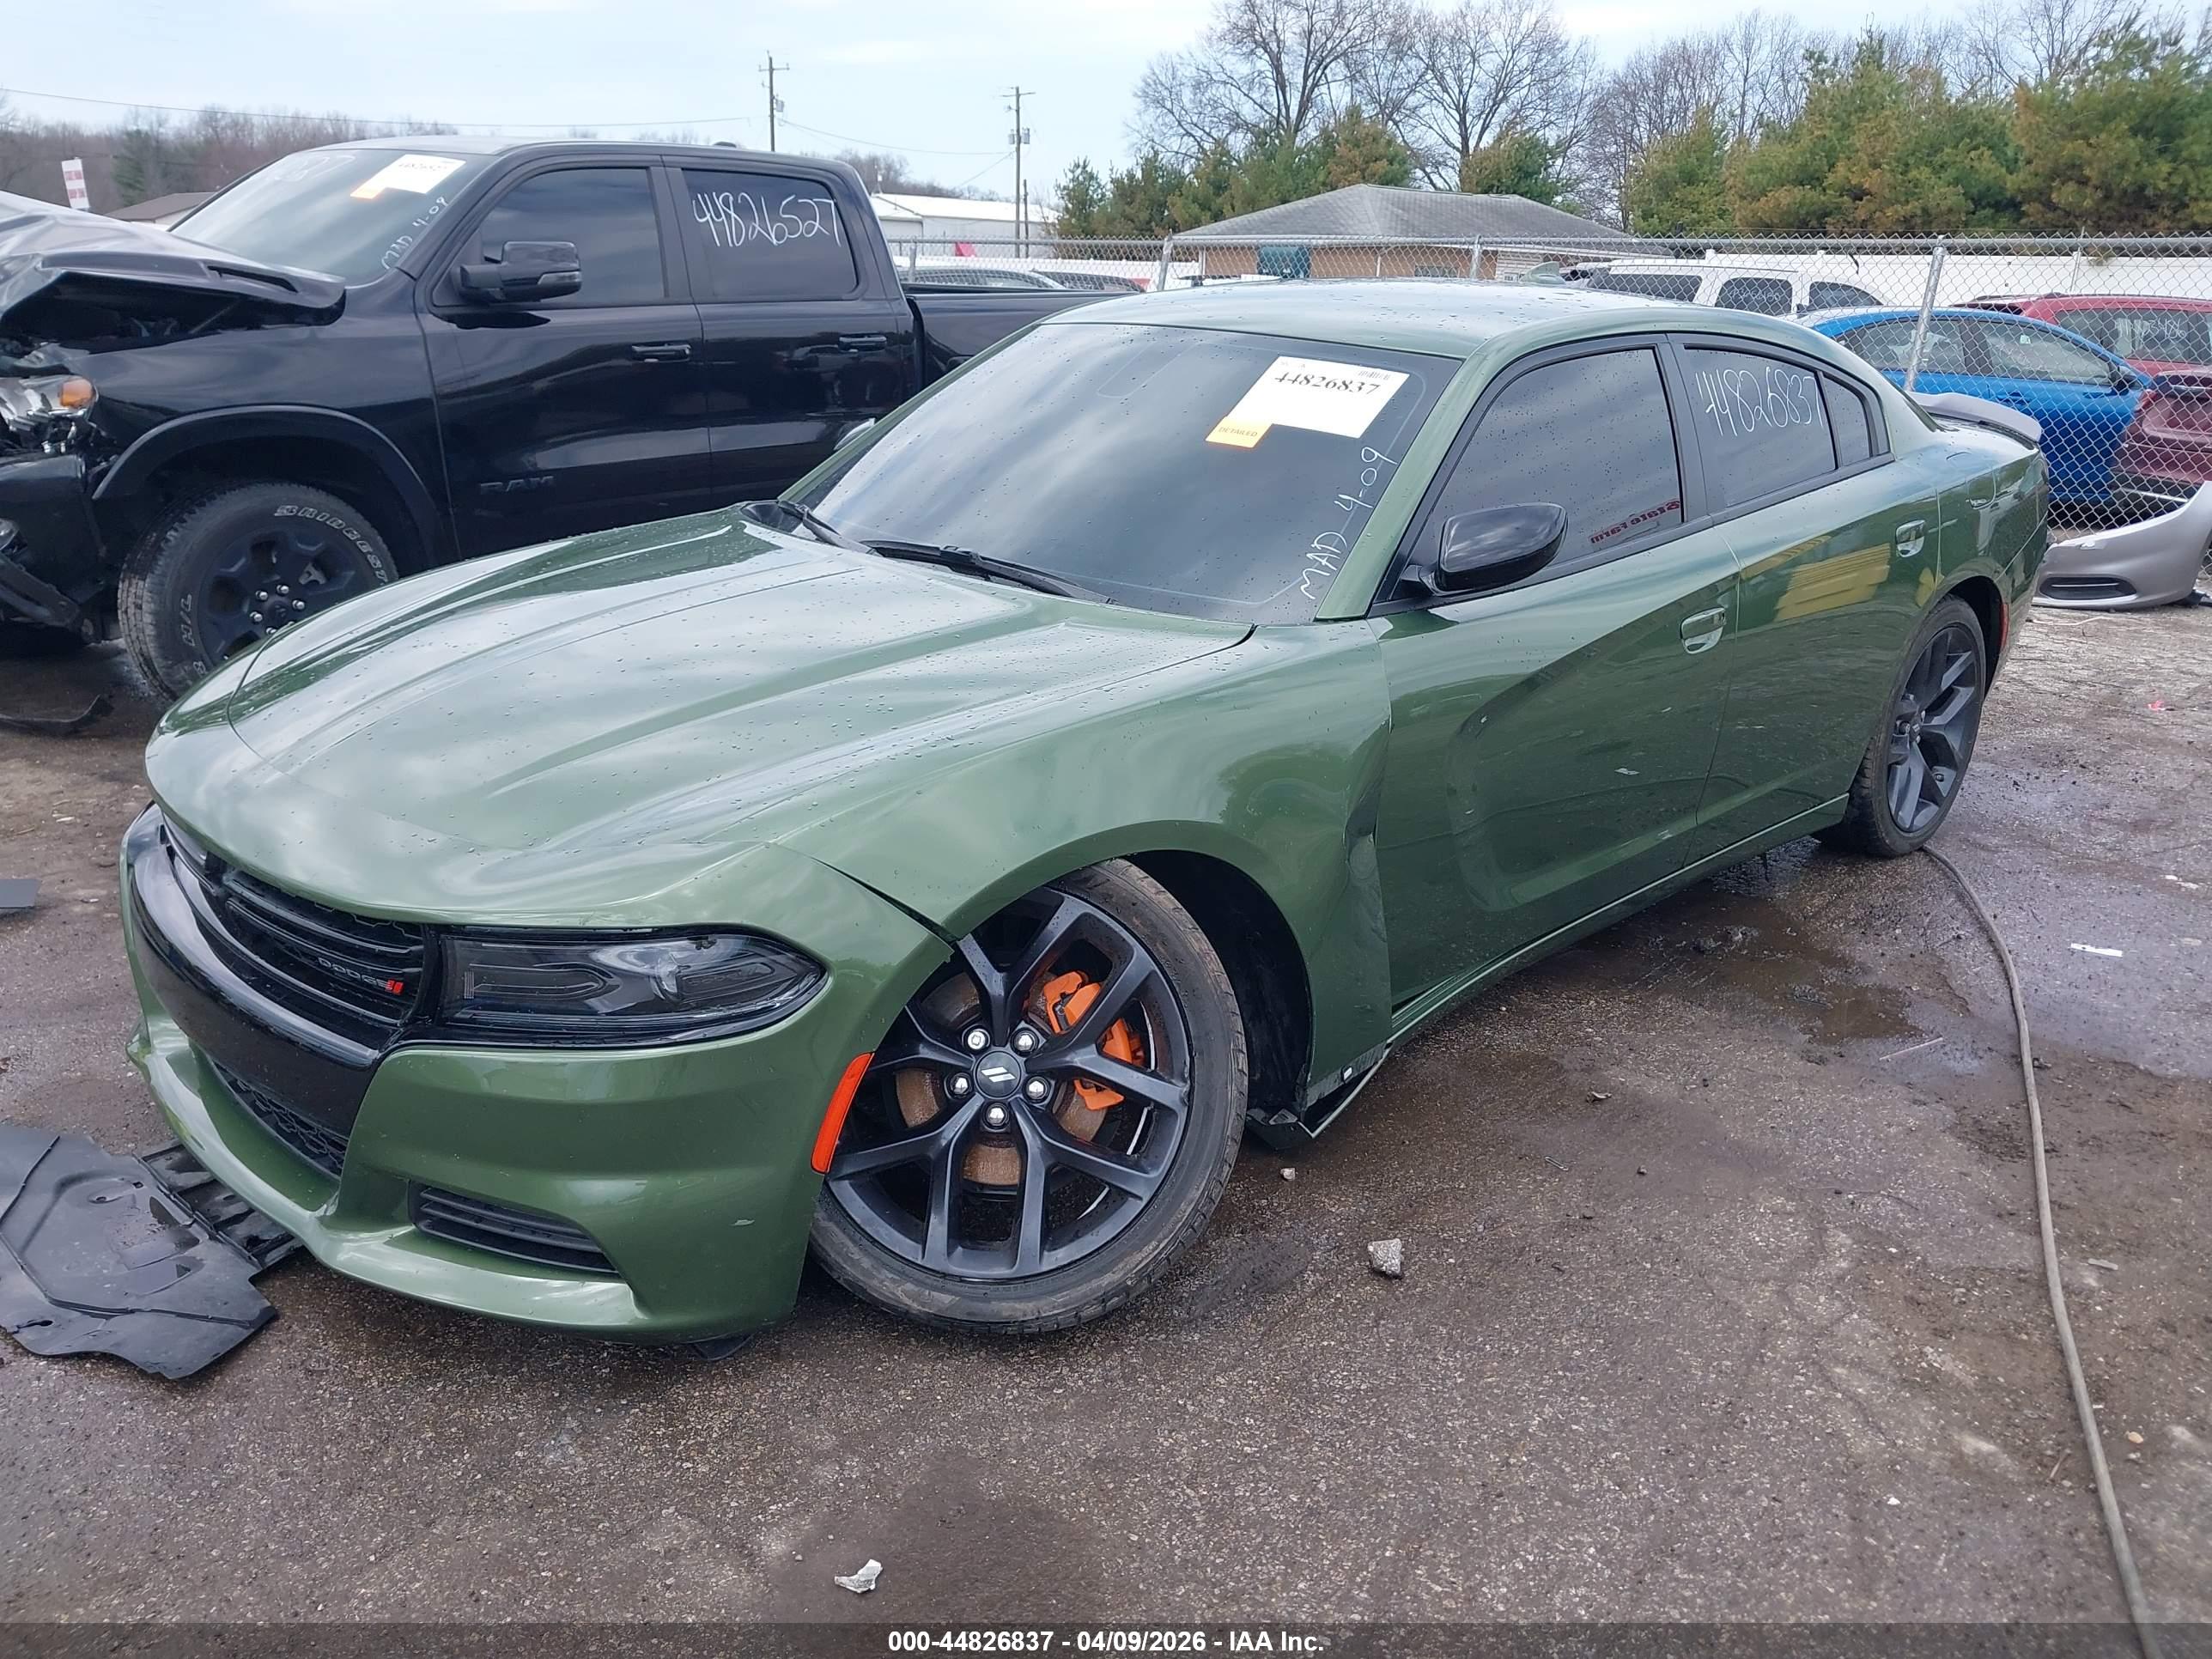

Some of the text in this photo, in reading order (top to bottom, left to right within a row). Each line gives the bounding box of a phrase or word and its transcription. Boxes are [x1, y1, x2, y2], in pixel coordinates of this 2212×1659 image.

[692, 191, 842, 247] 44826527
[1274, 372, 1381, 395] 44826837
[1695, 367, 1824, 436] 44826837
[274, 505, 388, 586] BRIDGEST
[1300, 532, 1347, 599] MAD
[1334, 447, 1398, 511] 4-09
